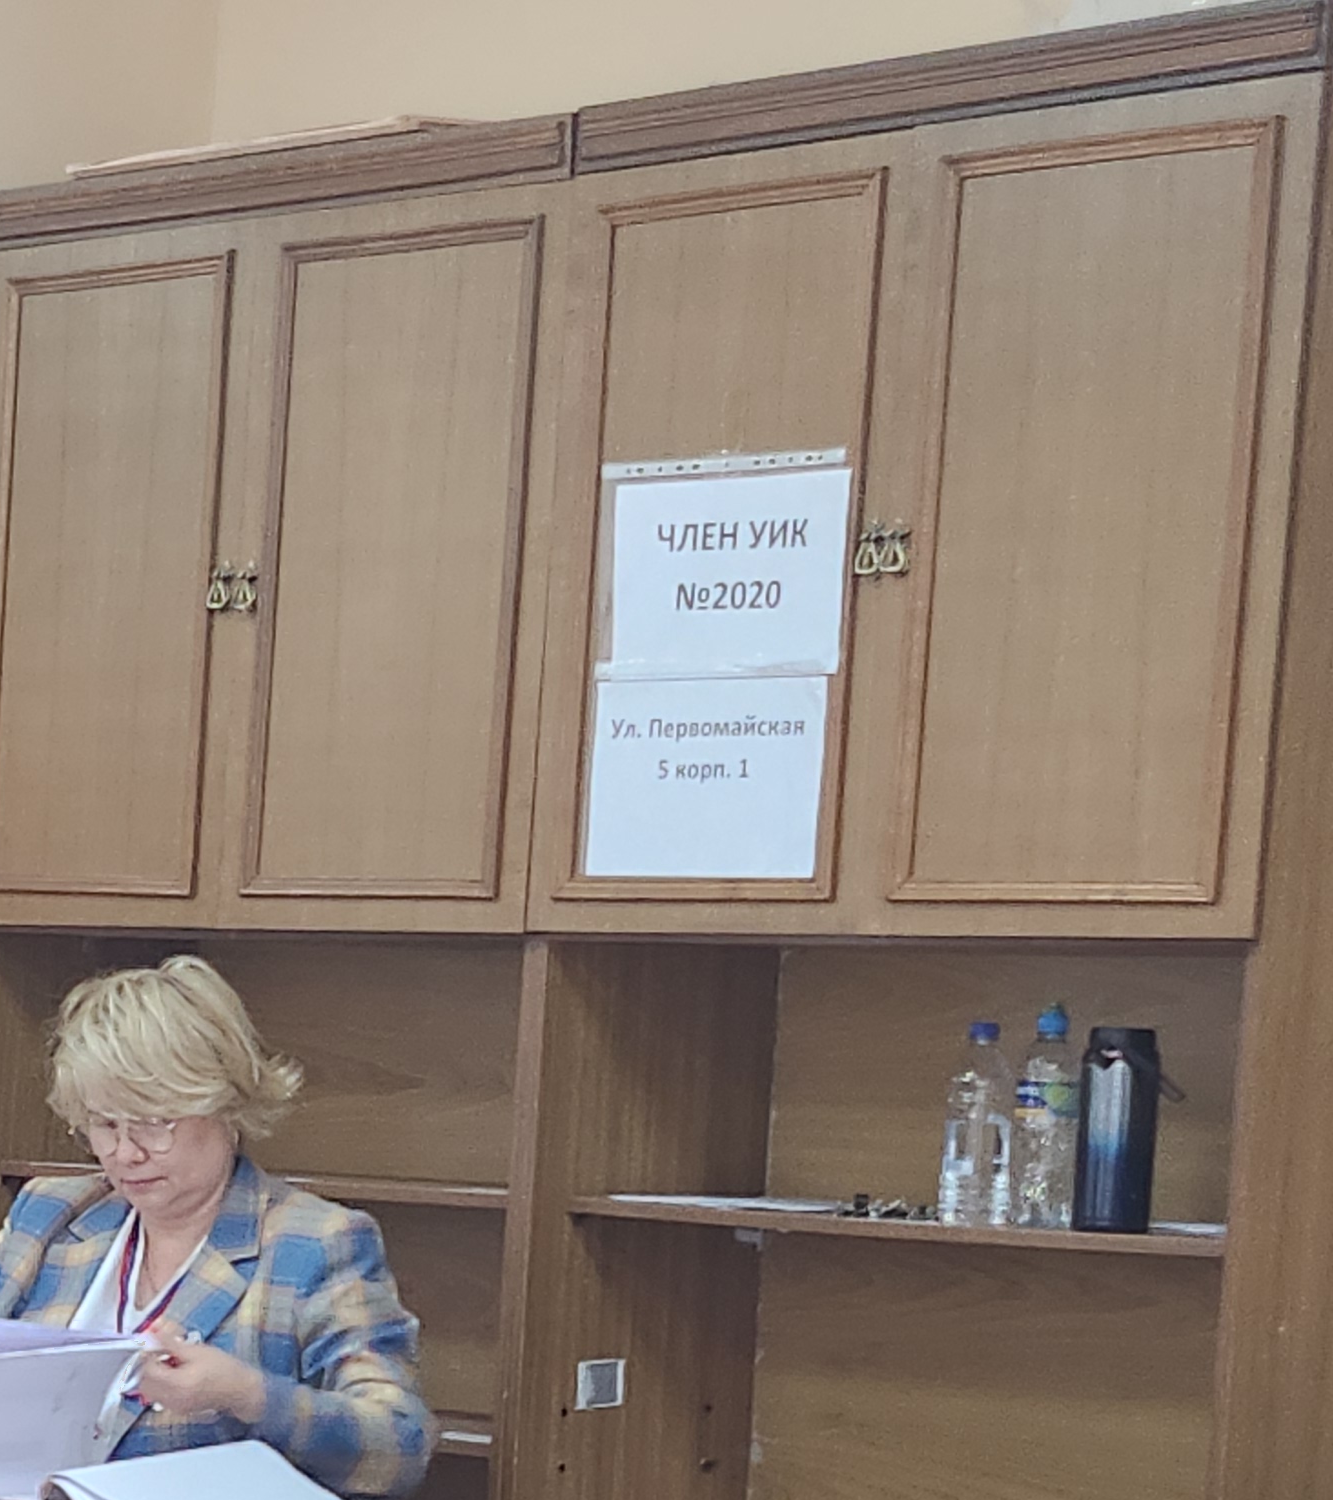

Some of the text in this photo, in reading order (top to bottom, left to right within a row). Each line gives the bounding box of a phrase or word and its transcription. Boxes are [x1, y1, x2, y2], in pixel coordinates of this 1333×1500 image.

[656, 518, 809, 552] ЧЛЕН УИК
[675, 580, 782, 612] №2020
[610, 715, 806, 744] Ул. Первомайская
[657, 759, 750, 783] 5 корп. 1
